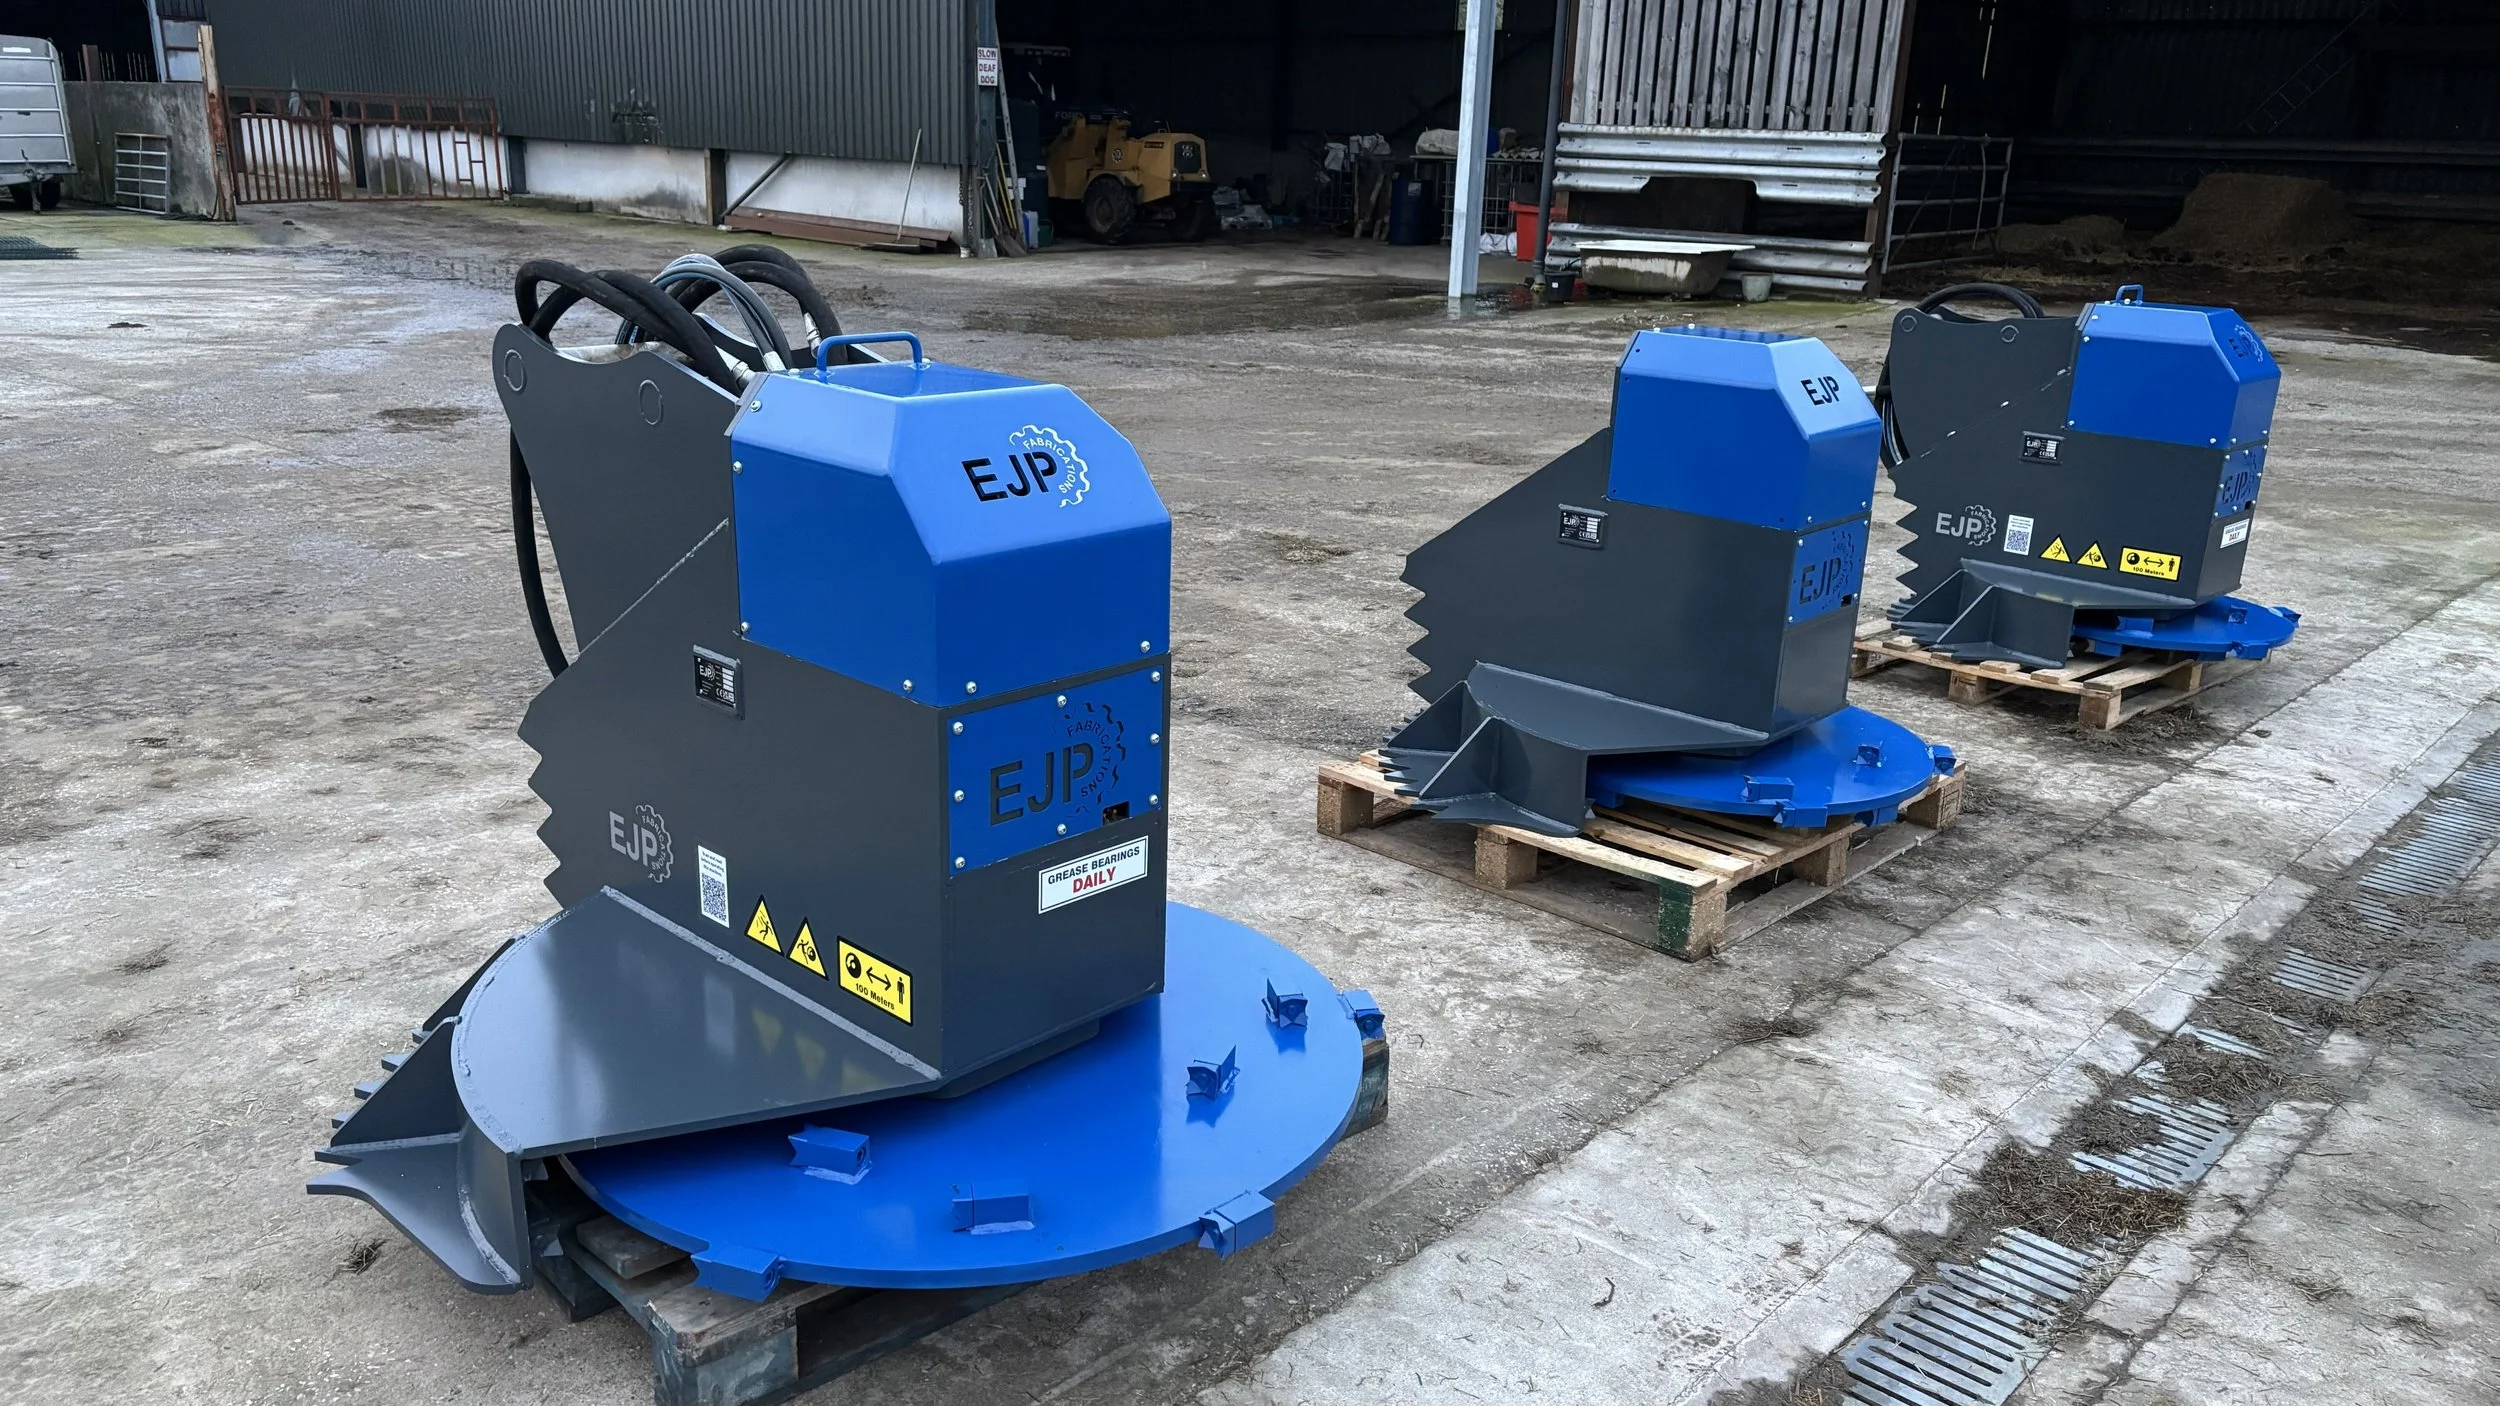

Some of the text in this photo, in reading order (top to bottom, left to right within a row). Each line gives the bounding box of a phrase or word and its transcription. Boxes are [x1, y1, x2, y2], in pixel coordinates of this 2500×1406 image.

[978, 50, 997, 58] SLOW
[979, 64, 996, 72] DEAF
[980, 76, 995, 84] DOG
[1800, 376, 1840, 406] EJP
[962, 451, 1057, 502] EJP
[1023, 437, 1076, 494] FABRICATIONS
[2222, 471, 2248, 505] EJP
[1935, 512, 1982, 539] EJP
[1970, 510, 1990, 540] FABRICATIONS
[1799, 557, 1841, 605] EJP
[700, 665, 712, 678] EJP
[1066, 720, 1112, 798] FABRICATIONS
[990, 743, 1094, 826] EJP
[609, 811, 658, 867] EJP
[642, 815, 667, 871] FABRICATIONS
[1048, 846, 1140, 885] GREASE BEARINGS
[1072, 866, 1116, 893] DAILY
[855, 982, 895, 1011] 100 Meters
